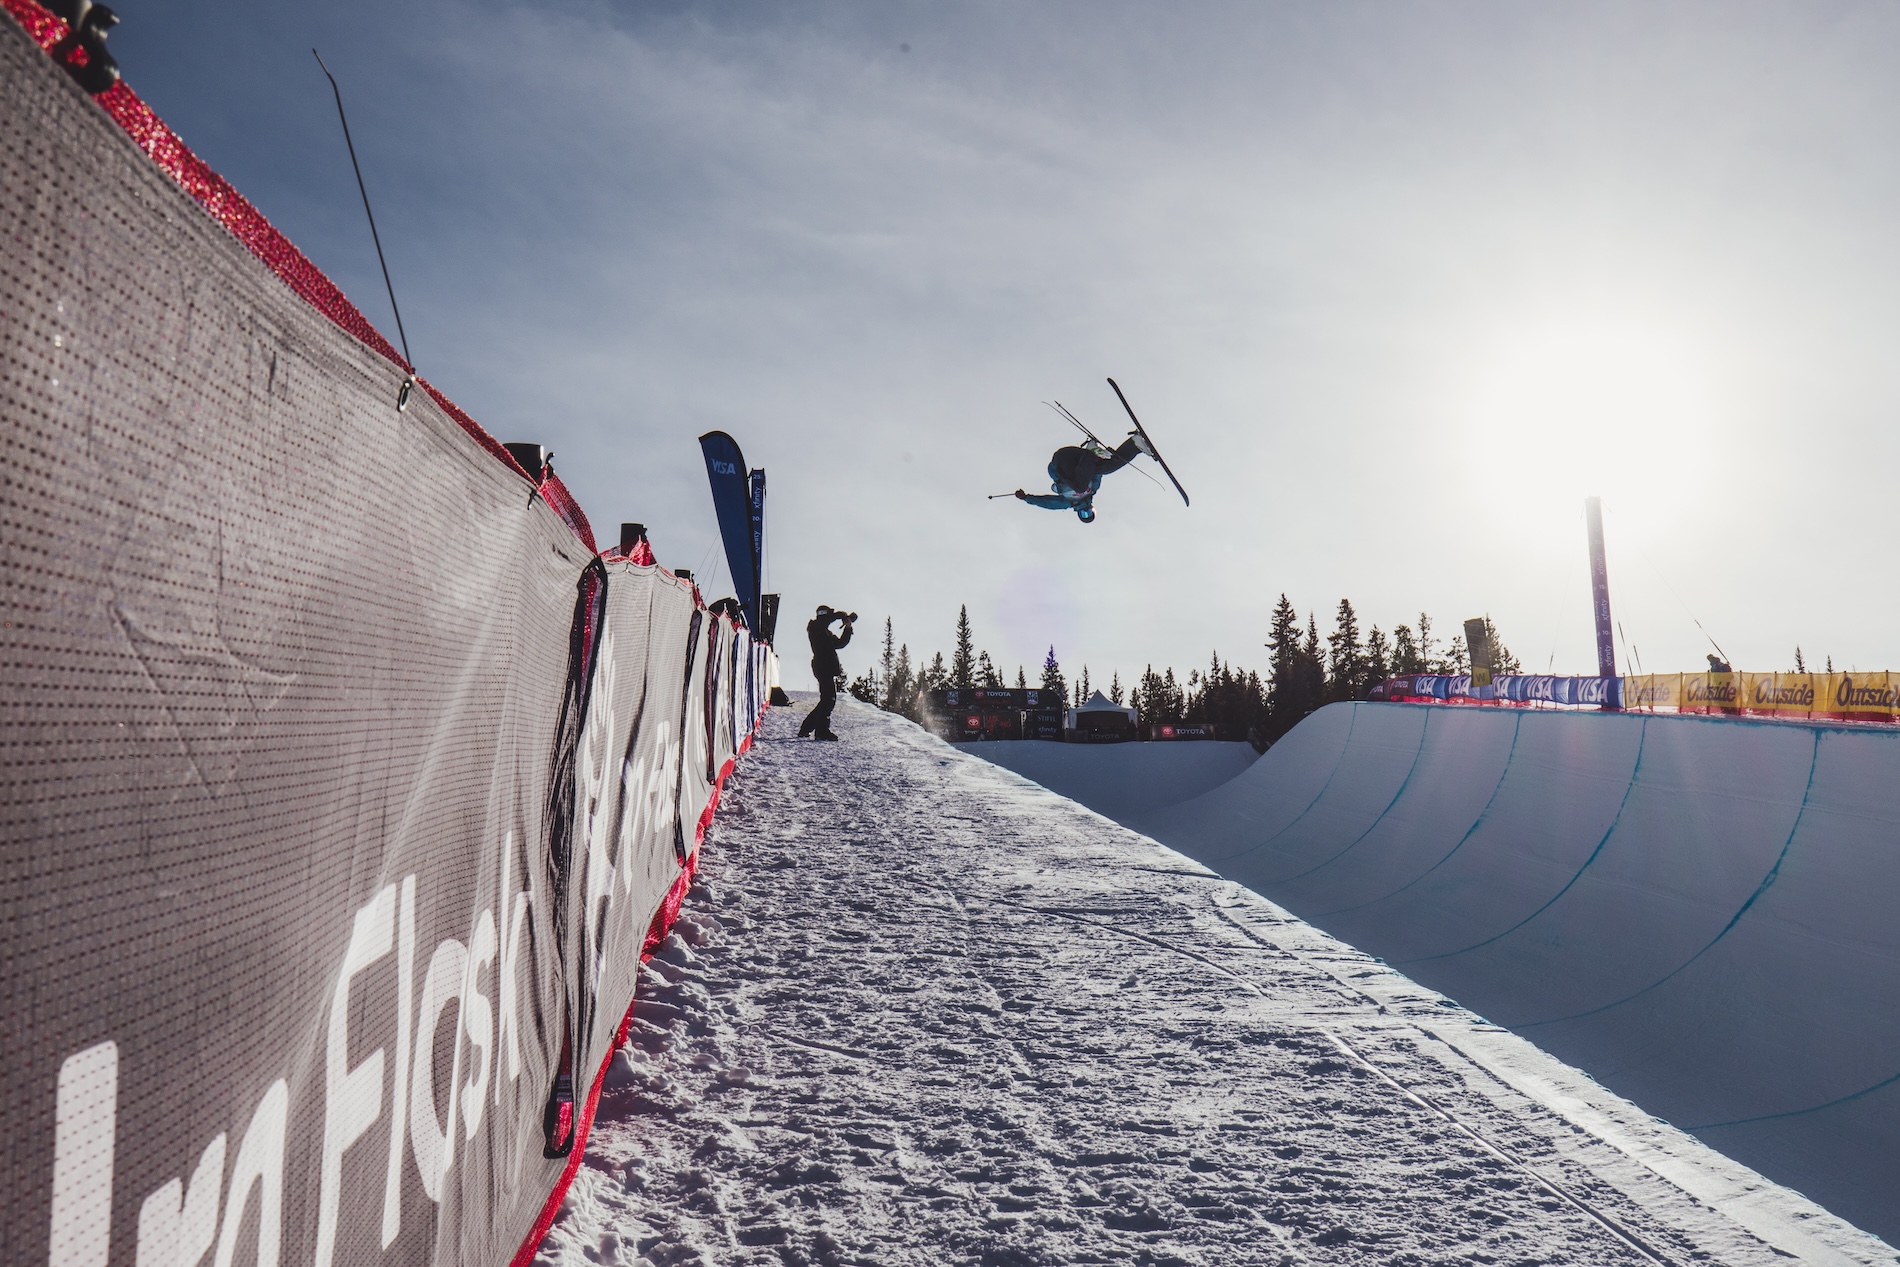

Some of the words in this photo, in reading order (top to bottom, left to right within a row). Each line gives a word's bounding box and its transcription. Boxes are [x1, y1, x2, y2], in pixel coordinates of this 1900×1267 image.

[711, 458, 736, 474] VISA
[753, 486, 762, 508] xfinity
[1605, 645, 1613, 667] xfinity
[1415, 677, 1437, 695] VISA
[1448, 677, 1471, 695] VISA
[1527, 677, 1554, 699] VISA
[1577, 679, 1609, 703] VISA
[1628, 679, 1670, 703] Outside
[1687, 677, 1736, 702] Outside
[1755, 677, 1814, 706] Outside
